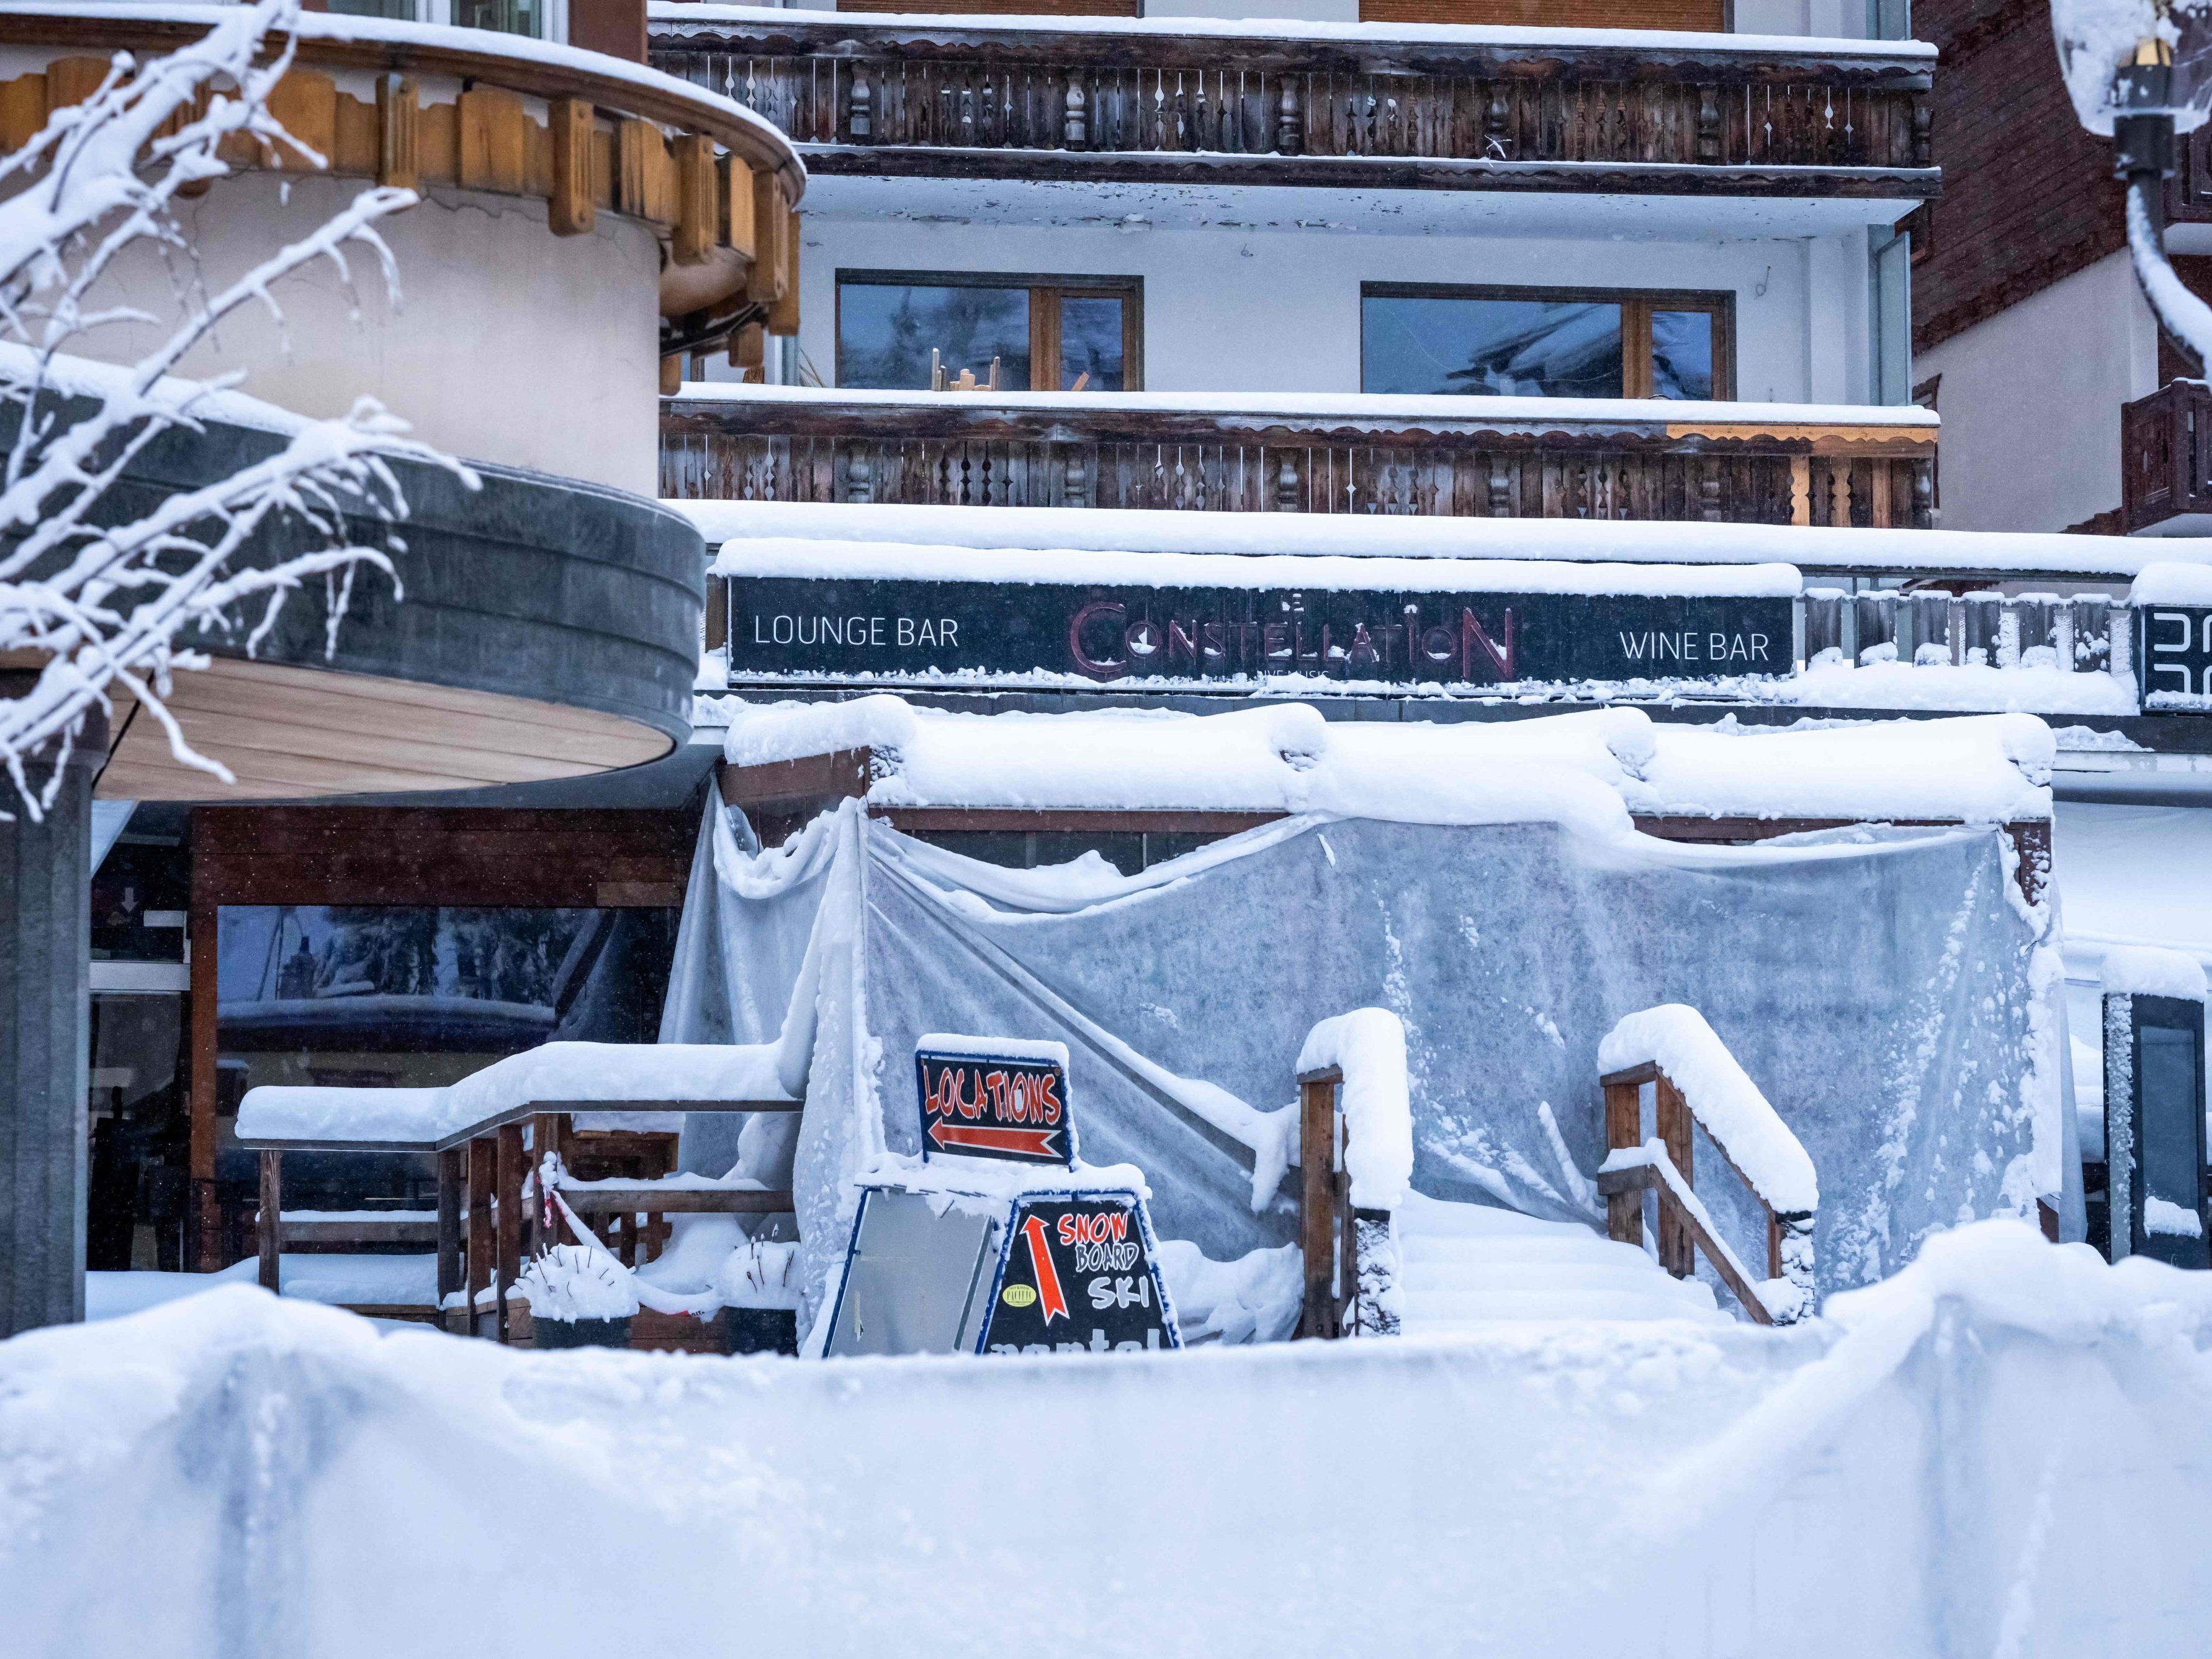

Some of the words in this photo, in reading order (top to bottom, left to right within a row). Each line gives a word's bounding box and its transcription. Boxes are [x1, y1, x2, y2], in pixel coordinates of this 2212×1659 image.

[755, 615, 886, 646] LOUNGE
[897, 617, 959, 647] BAR
[1619, 631, 1699, 660] WINE
[1710, 632, 1769, 661] BAR
[923, 1064, 1062, 1125] LOCATIONS
[1057, 1212, 1129, 1246] SNOW
[1075, 1241, 1140, 1273] BOARD
[1087, 1275, 1150, 1310] SKI
